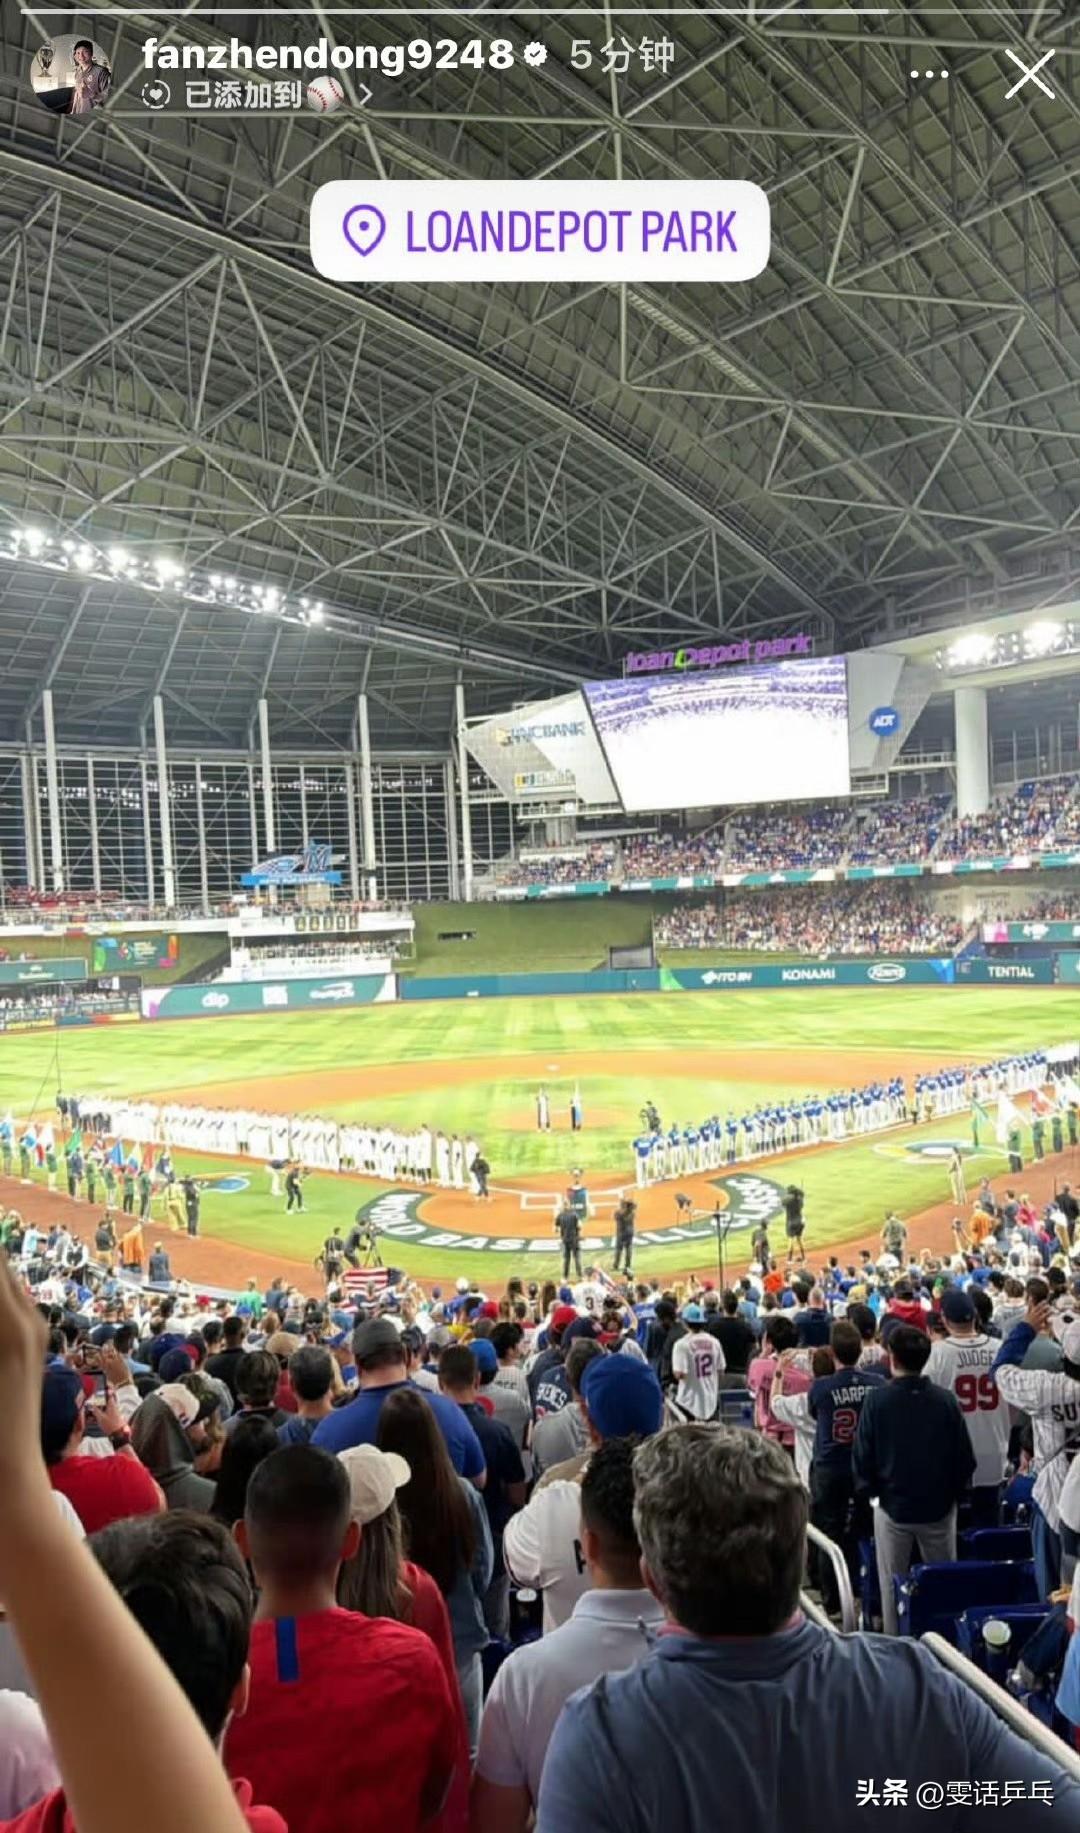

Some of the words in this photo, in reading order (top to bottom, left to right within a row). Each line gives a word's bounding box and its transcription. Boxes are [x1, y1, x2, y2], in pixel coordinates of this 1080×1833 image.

[756, 632, 812, 661] park
[873, 714, 895, 728] ADT
[782, 967, 836, 980] KONAMI
[987, 965, 1035, 979] TENTIAL
[369, 1192, 428, 1236] WORLD
[585, 1297, 595, 1311] 3
[694, 1353, 713, 1379] 12
[957, 1349, 995, 1369] JUDGE
[831, 1386, 871, 1406] HARP
[954, 1374, 999, 1413] 99
[1051, 1403, 1080, 1422] SU
[832, 1408, 857, 1444] 2
